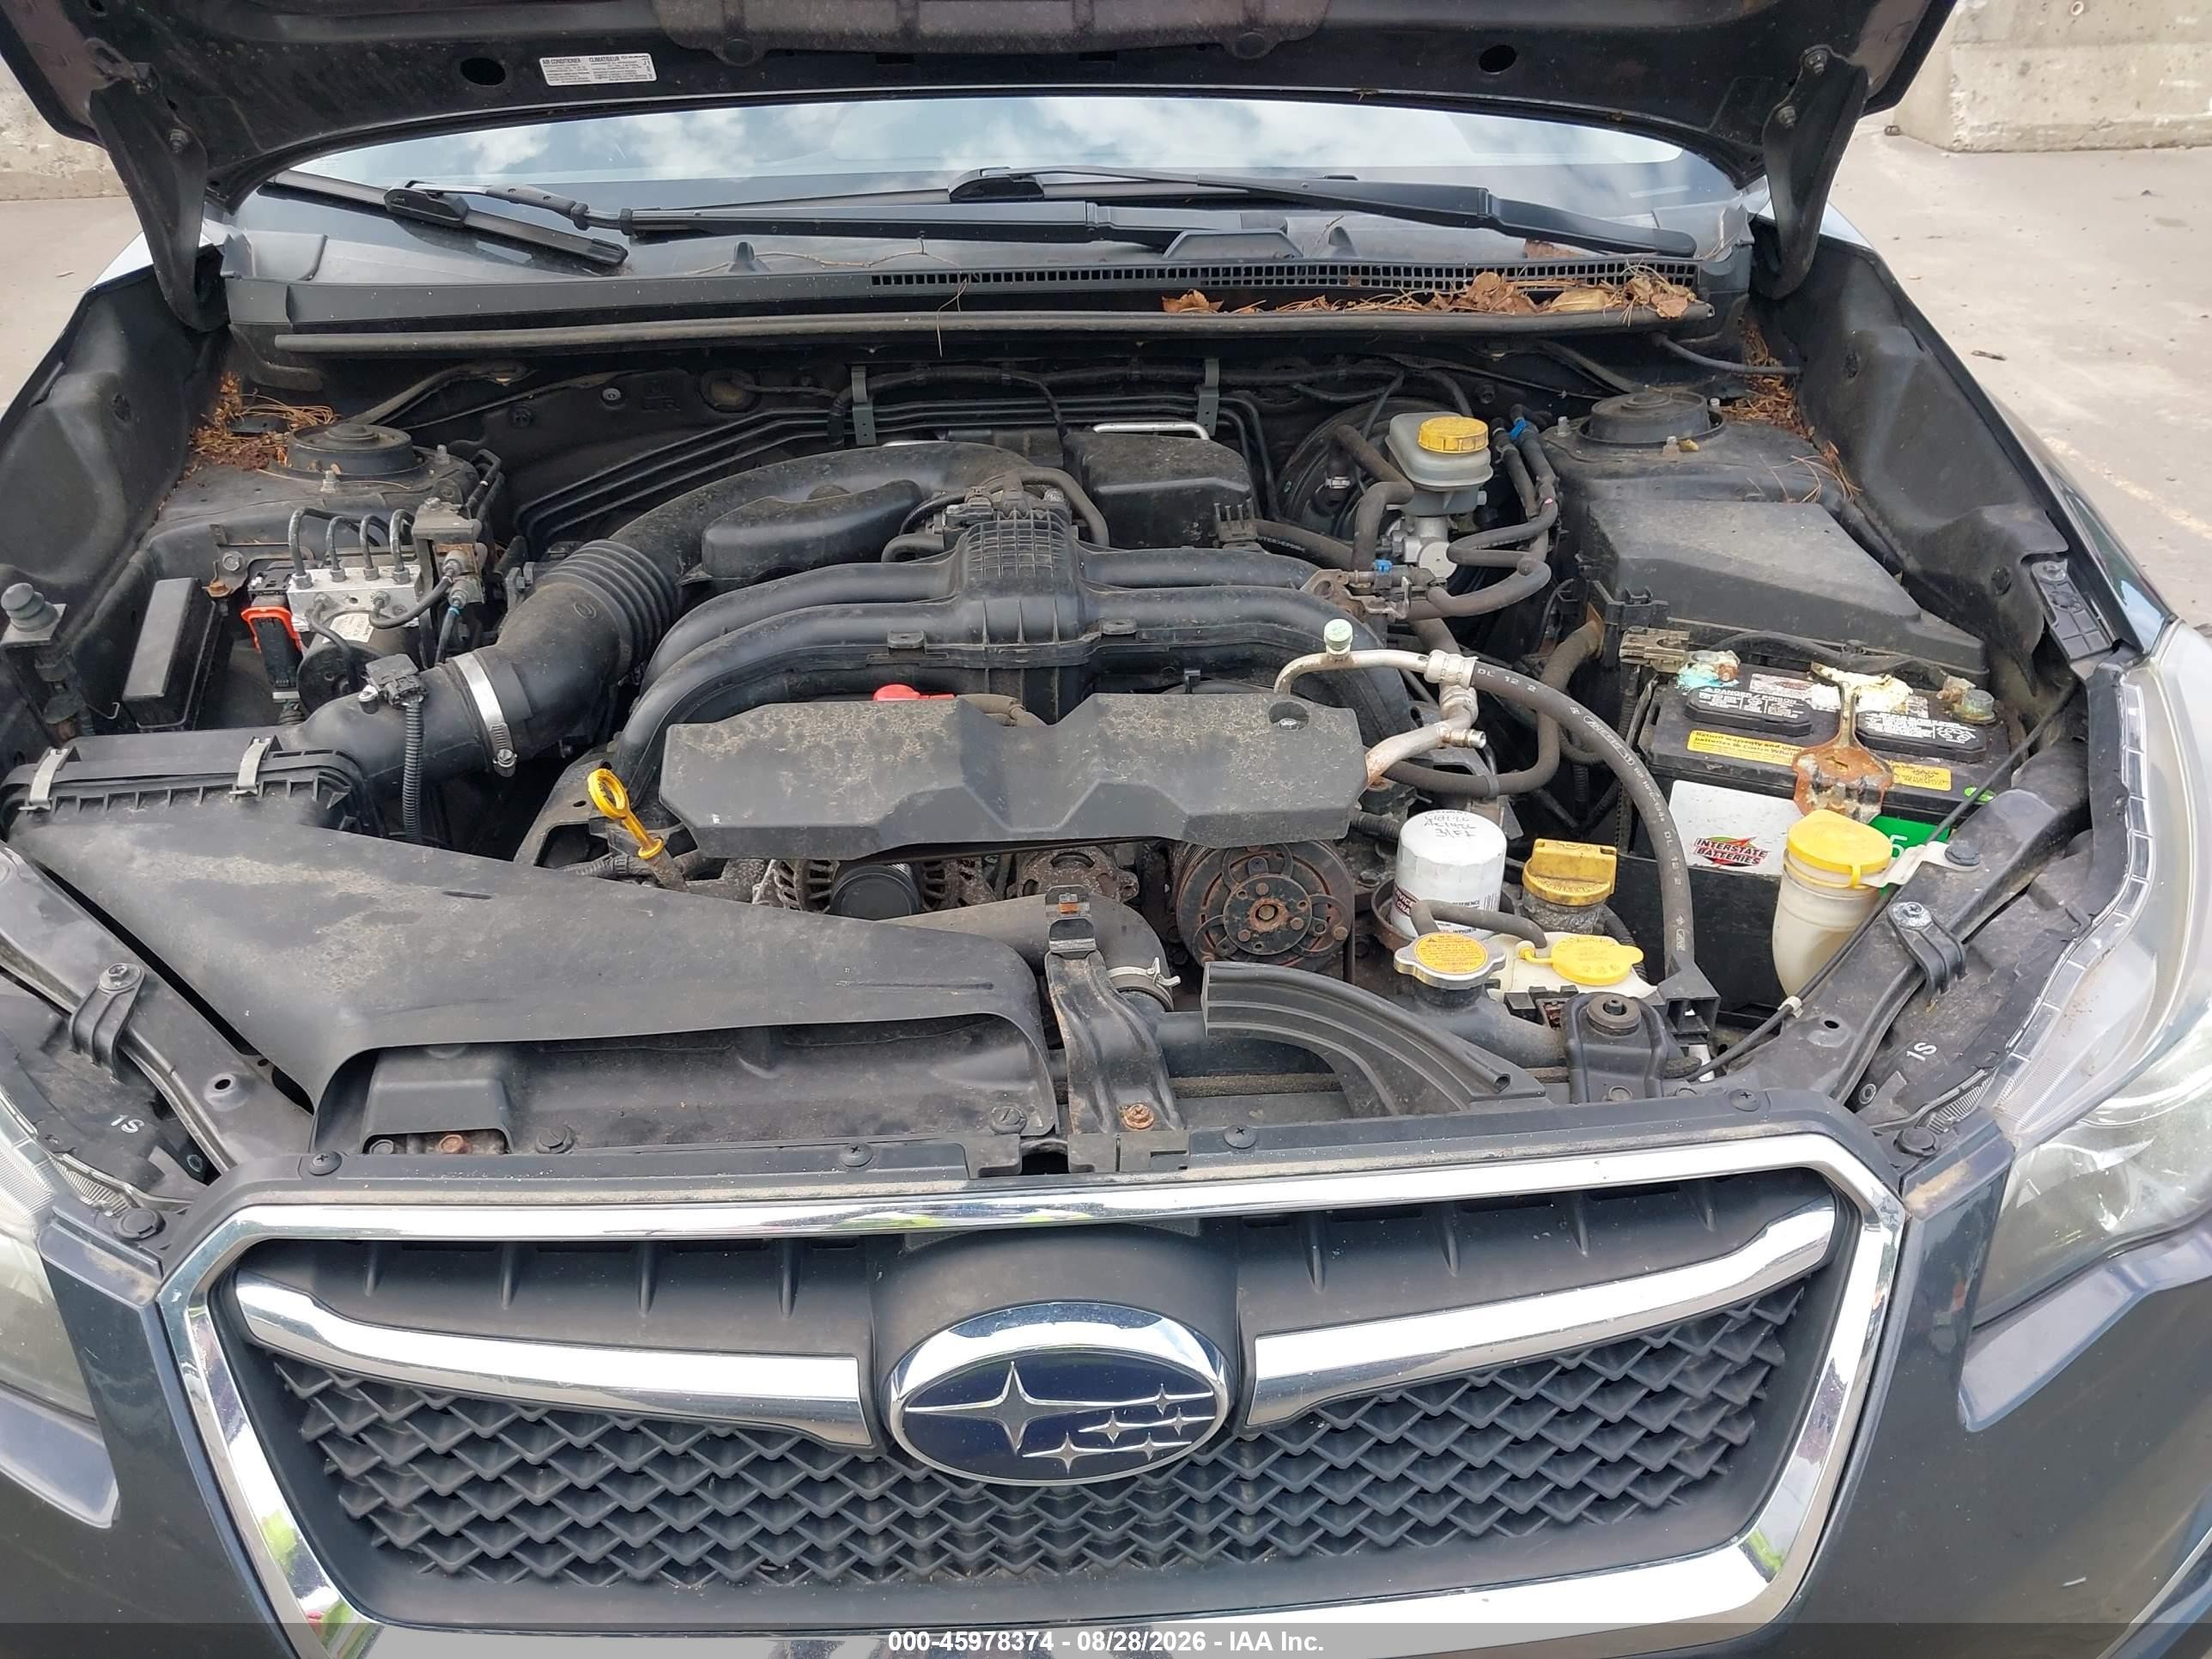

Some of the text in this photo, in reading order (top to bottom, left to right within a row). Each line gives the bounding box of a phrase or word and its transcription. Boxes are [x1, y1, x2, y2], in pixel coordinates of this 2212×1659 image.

[1477, 668, 1495, 678] DL
[1504, 676, 1519, 685] 12
[1694, 738, 1731, 747] batteries
[1695, 847, 1761, 865] BATTERIES
[1696, 839, 1769, 858] INTERSTATE
[111, 1115, 145, 1133] 1S
